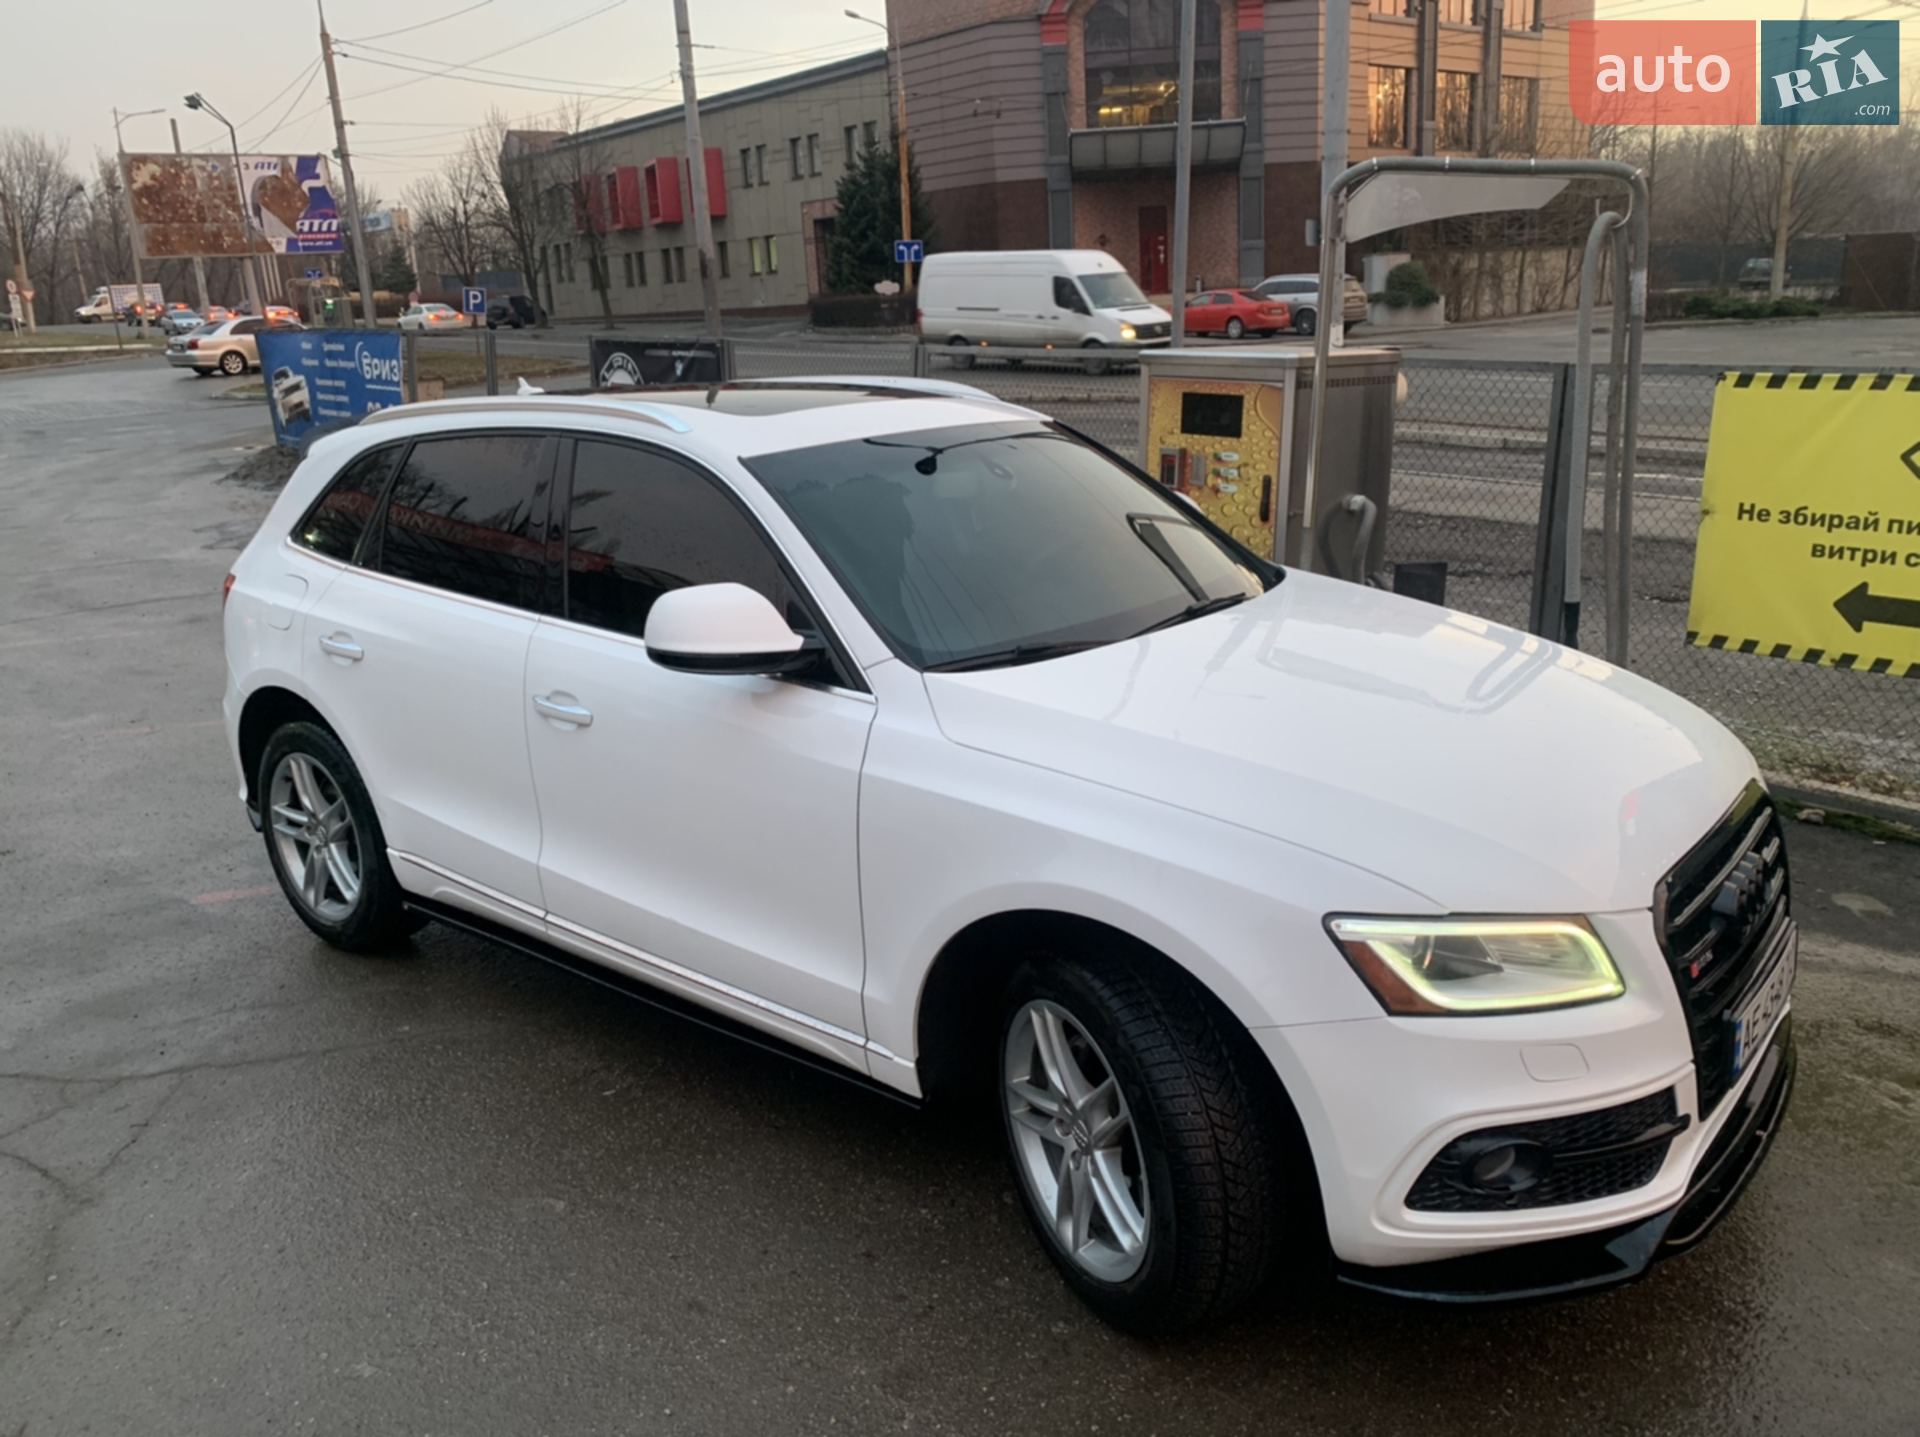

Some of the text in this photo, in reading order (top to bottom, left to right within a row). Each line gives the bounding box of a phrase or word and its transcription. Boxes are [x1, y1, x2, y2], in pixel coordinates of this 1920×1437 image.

[468, 290, 483, 312] P
[361, 350, 400, 383] БРИЗ
[600, 356, 640, 386] LPIN
[1737, 502, 1771, 523] Не
[1778, 506, 1880, 533] збирай
[1811, 543, 1898, 568] витри
